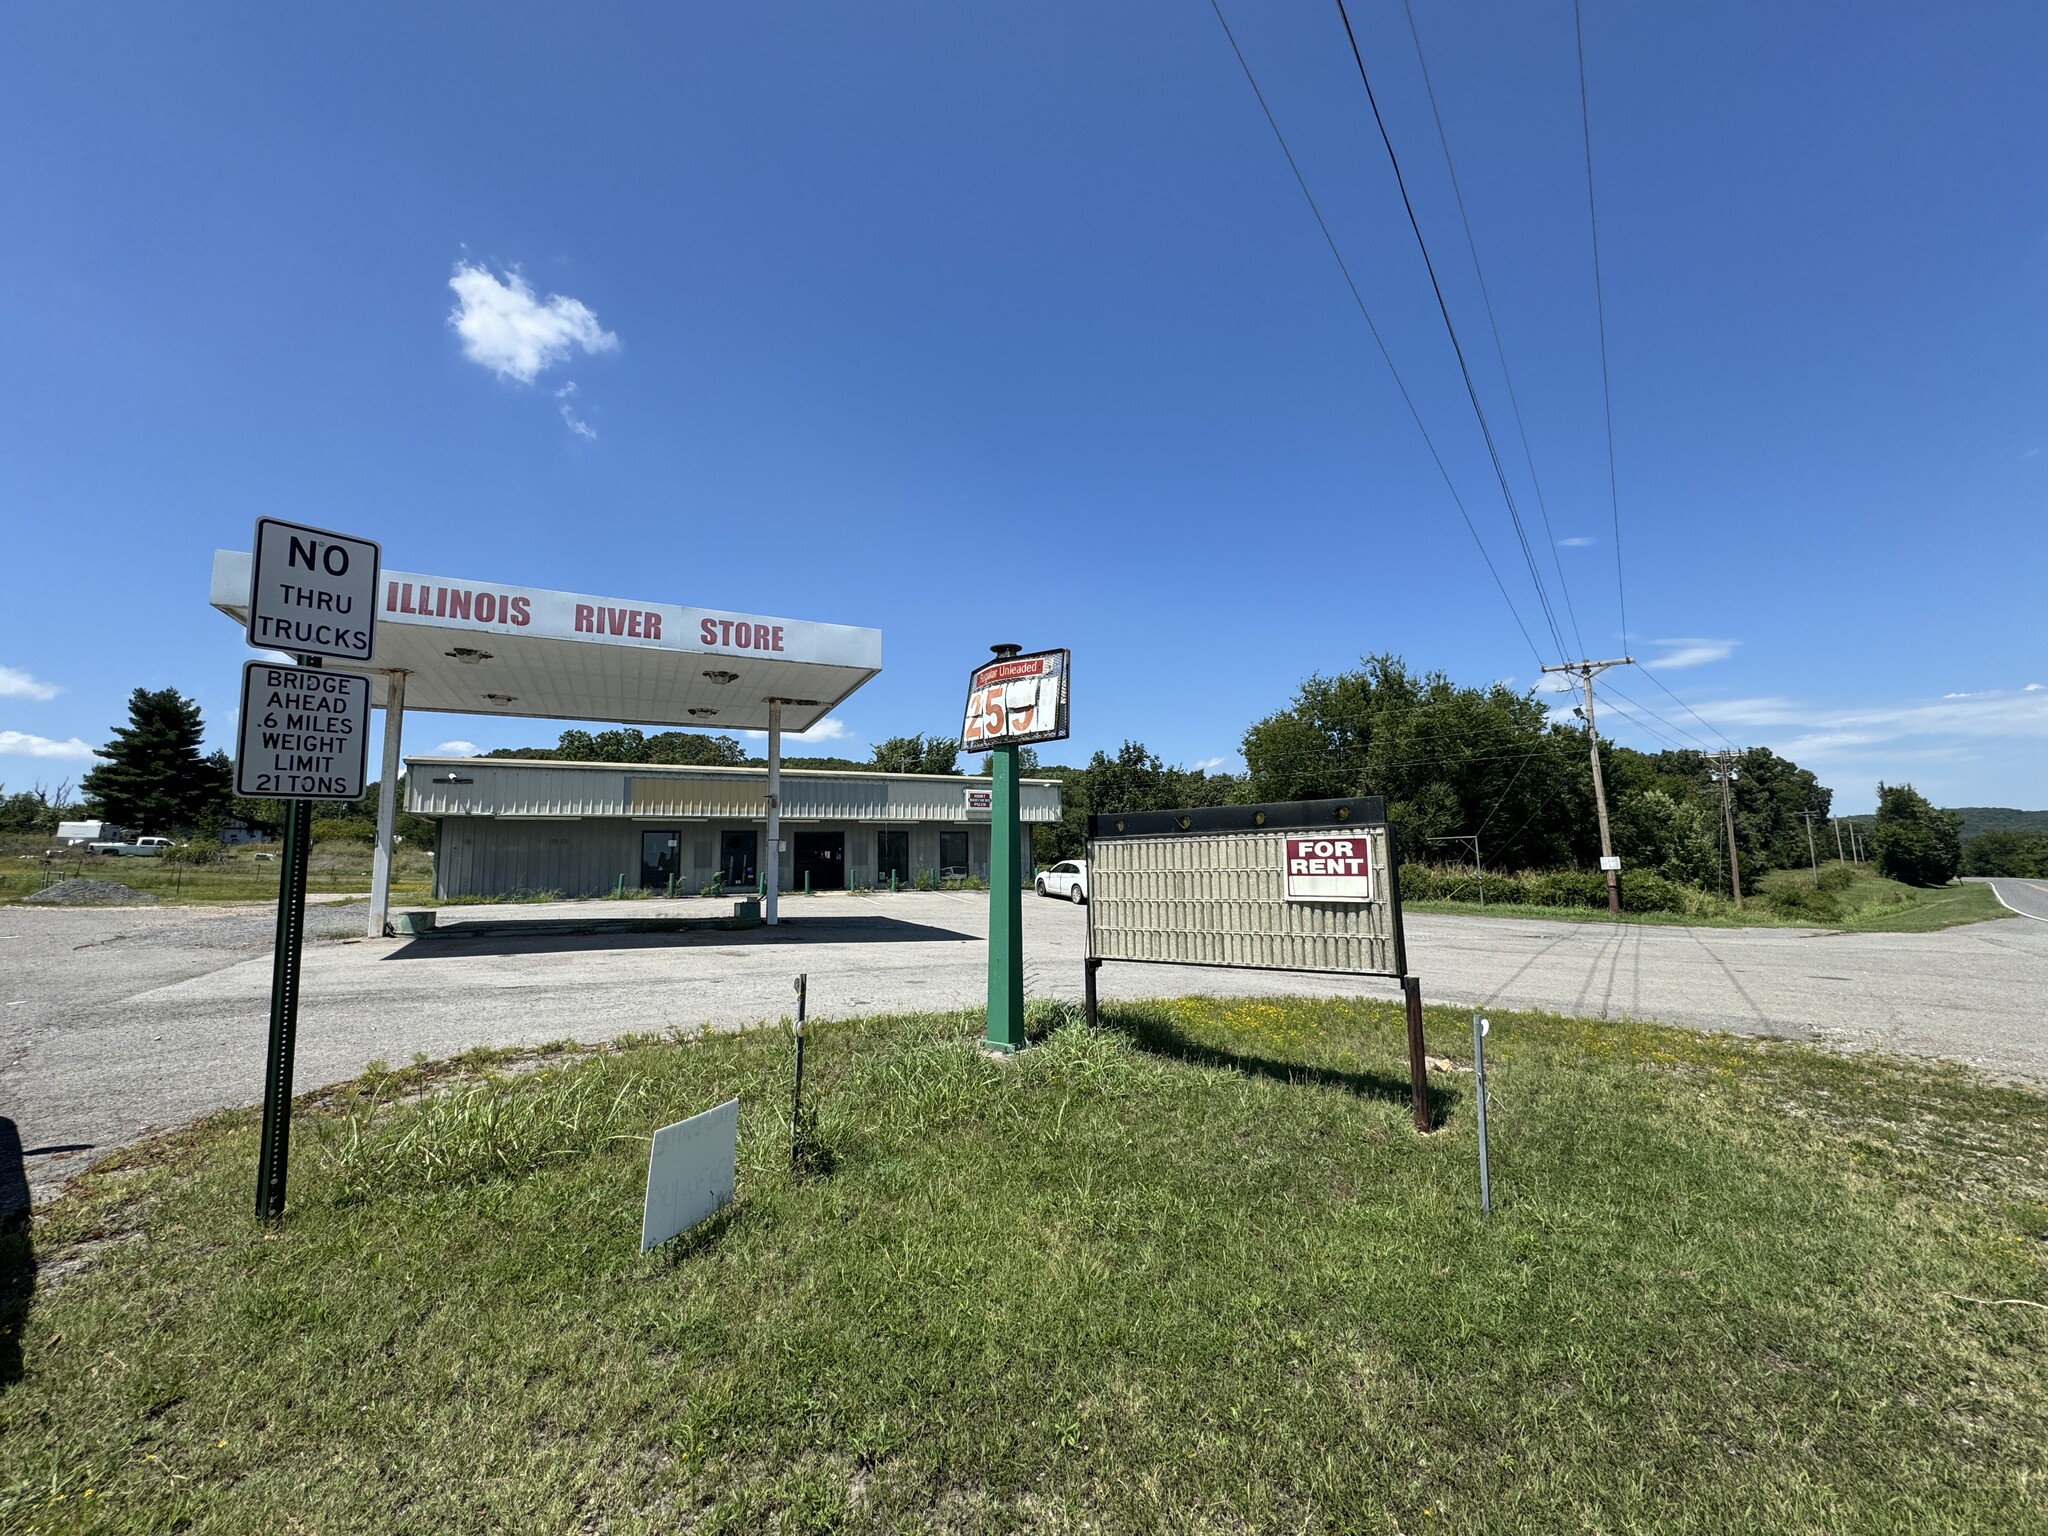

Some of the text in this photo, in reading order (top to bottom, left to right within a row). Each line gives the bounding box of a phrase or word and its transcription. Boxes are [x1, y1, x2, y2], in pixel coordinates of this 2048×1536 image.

[288, 536, 350, 577] NO
[280, 584, 352, 614] THRU
[386, 581, 785, 652] ILLINOIS RIVER STORE
[258, 615, 367, 650] TRUCKS
[999, 661, 1038, 677] Unleaded
[268, 670, 351, 695] BRIDGE
[267, 691, 347, 714] AHEAD
[257, 711, 353, 735] .6 MILES
[262, 732, 348, 754] WEIGHT
[275, 753, 334, 773] LIMIT
[256, 774, 347, 794] 21 TONS
[1298, 841, 1353, 857] FOR
[1290, 858, 1364, 875] RENT
